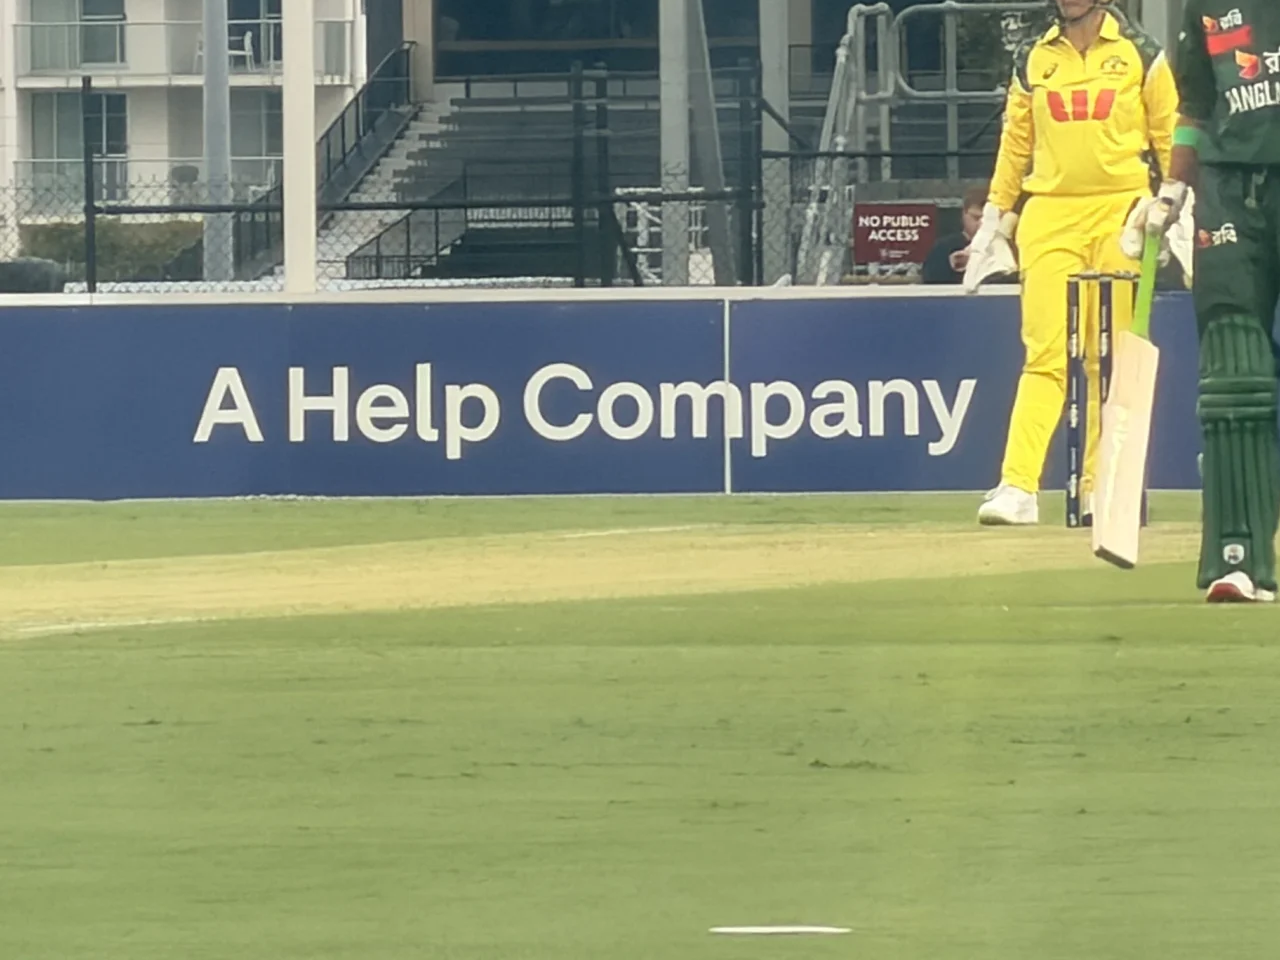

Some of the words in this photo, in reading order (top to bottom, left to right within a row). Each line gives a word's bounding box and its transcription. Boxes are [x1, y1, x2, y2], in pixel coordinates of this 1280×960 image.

[858, 215, 881, 228] NO
[882, 214, 930, 228] PUBLIC
[867, 228, 920, 242] ACCESS
[193, 367, 264, 443] A
[288, 363, 500, 460] Help
[523, 363, 978, 458] Company
